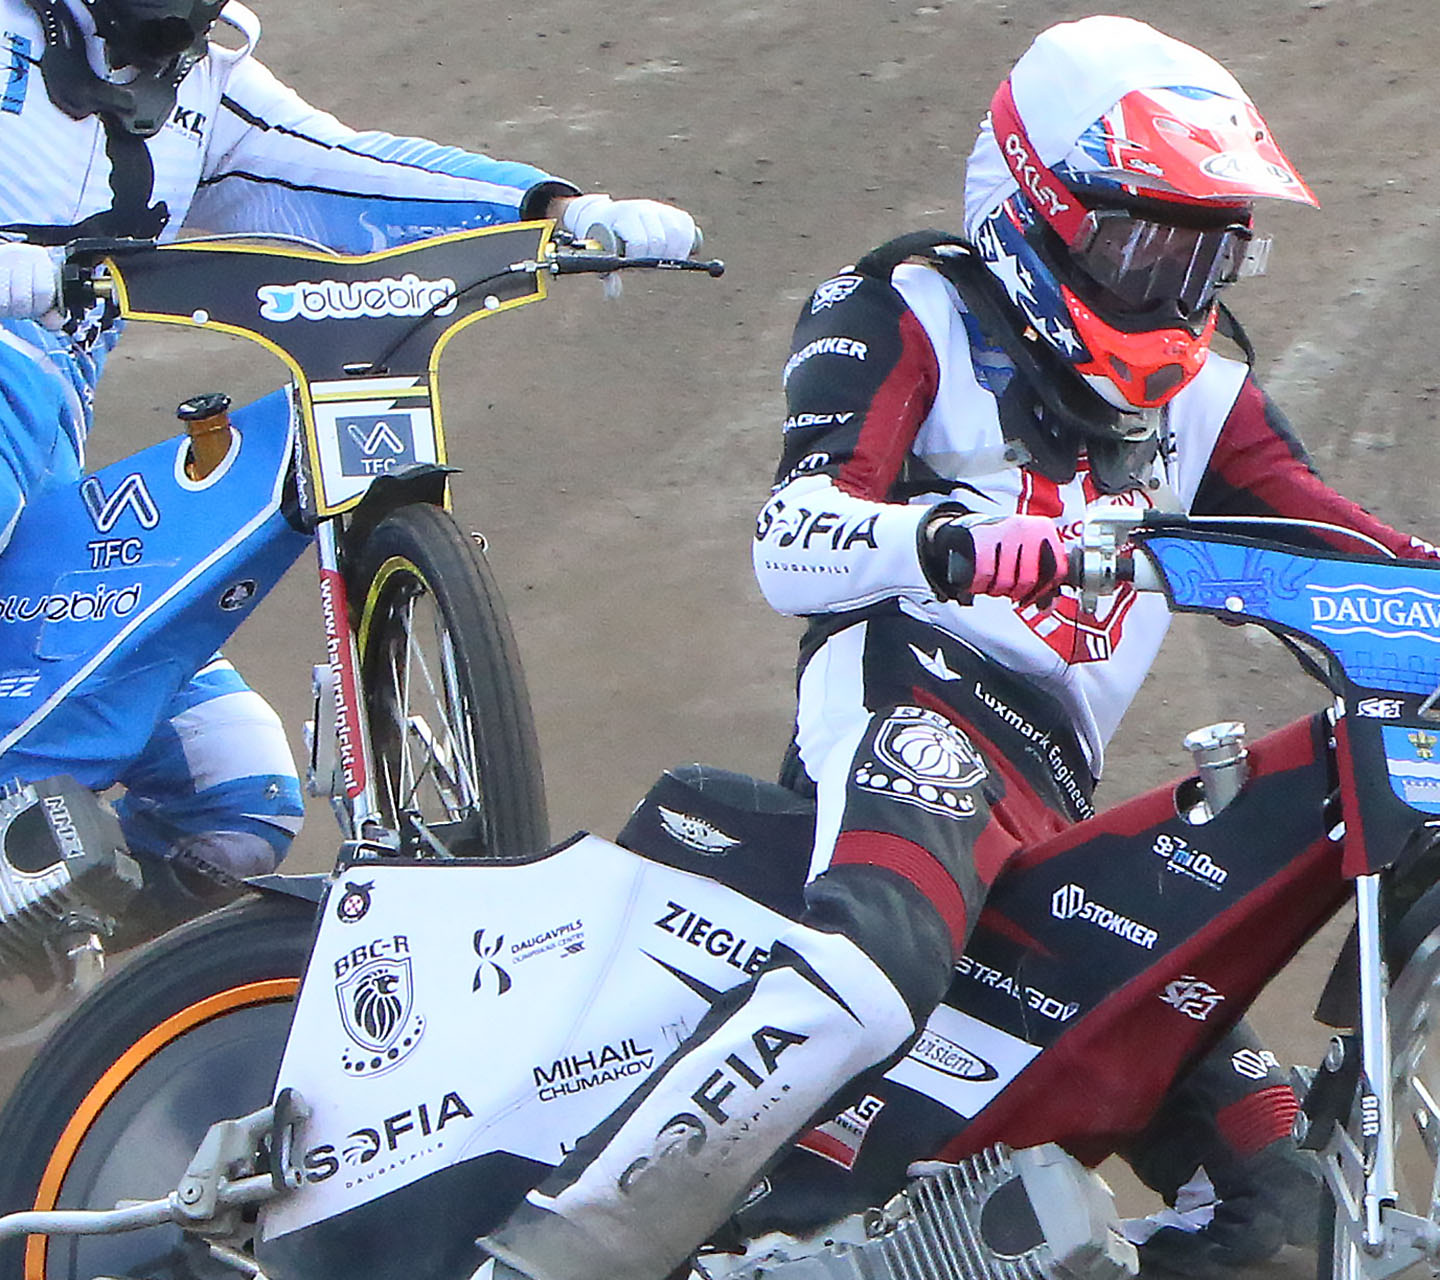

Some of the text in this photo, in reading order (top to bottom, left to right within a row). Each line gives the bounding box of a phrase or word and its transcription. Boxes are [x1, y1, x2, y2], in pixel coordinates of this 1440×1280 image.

[1005, 133, 1070, 217] OAKLEY
[301, 276, 456, 316] bluebird
[87, 539, 143, 567] TFC
[973, 680, 1051, 752] Luxmark
[511, 918, 583, 954] DAUGAVPILS
[655, 901, 770, 978] ZIEGLE
[1080, 900, 1158, 951] STOKKER
[334, 934, 410, 980] BBC-R
[532, 1038, 654, 1088] MIHAIL
[538, 1056, 656, 1103] CHUMAKOV
